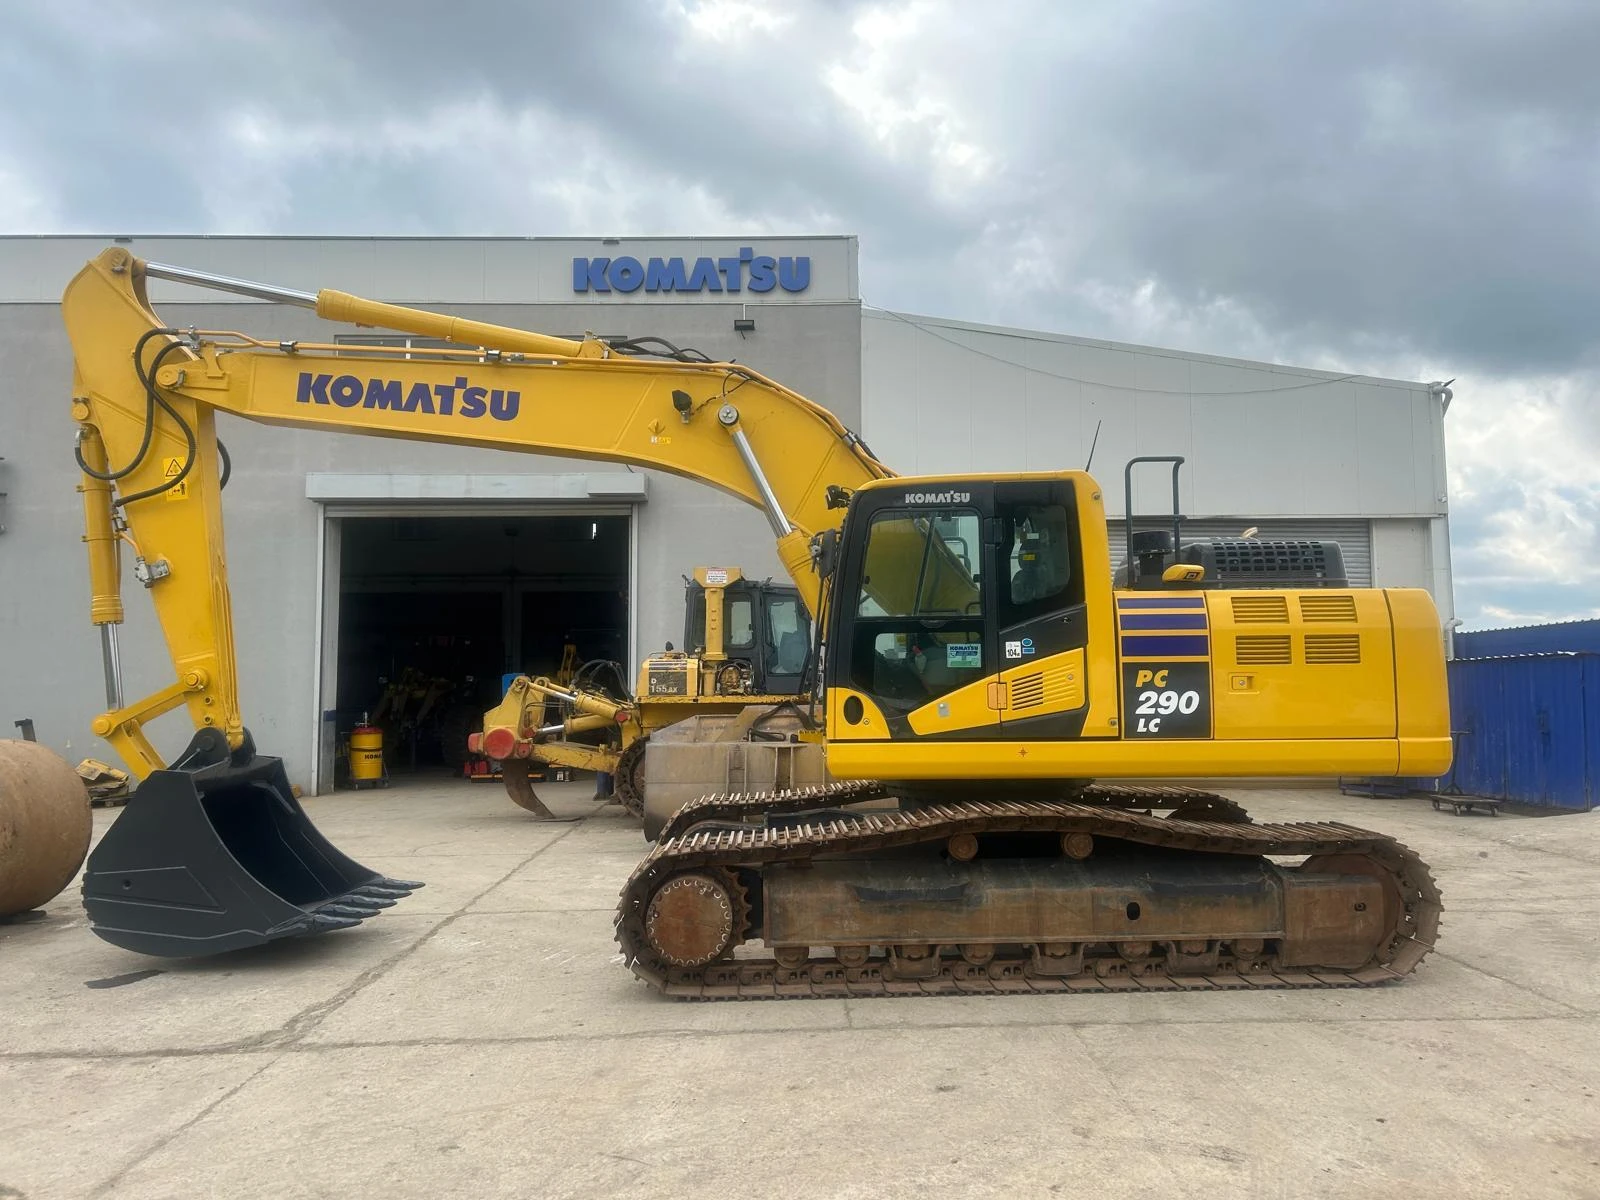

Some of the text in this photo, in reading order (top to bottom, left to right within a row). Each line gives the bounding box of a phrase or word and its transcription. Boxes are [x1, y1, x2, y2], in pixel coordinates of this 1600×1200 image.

[573, 247, 810, 293] KOMATSU
[296, 372, 521, 421] KOMATSU
[905, 490, 971, 504] KOMATSU
[1135, 669, 1169, 688] PC
[1135, 690, 1200, 715] 290
[1136, 718, 1161, 733] LC
